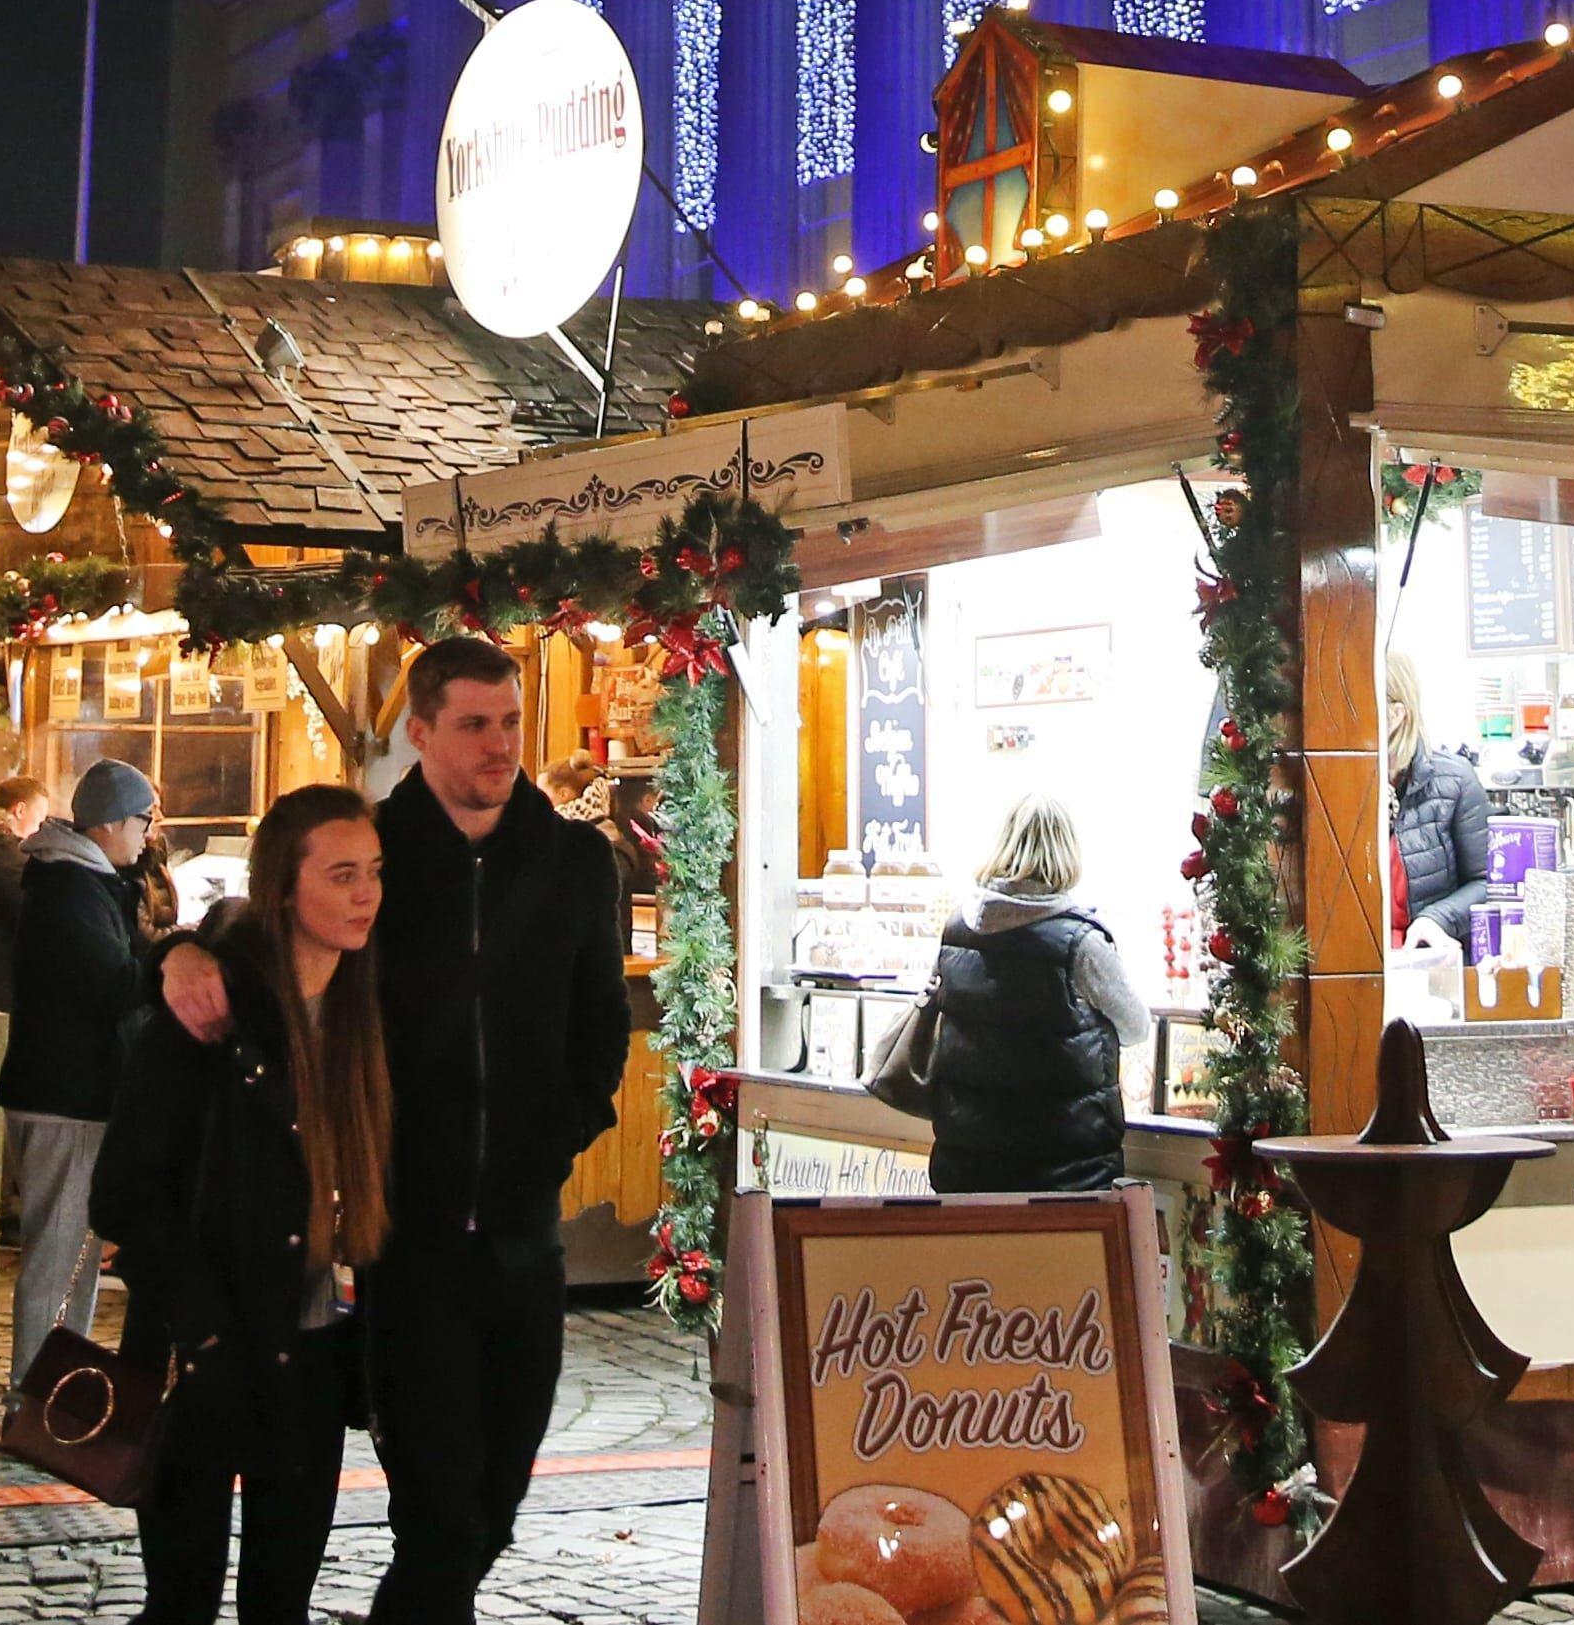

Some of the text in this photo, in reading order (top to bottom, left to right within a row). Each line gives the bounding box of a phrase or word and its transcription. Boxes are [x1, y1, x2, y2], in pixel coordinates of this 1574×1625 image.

[537, 69, 628, 165] Pudding
[773, 1143, 933, 1197] Luxury Hot Choco
[811, 1278, 1115, 1386] Hot Fresh
[853, 1372, 1085, 1462] Donuts
